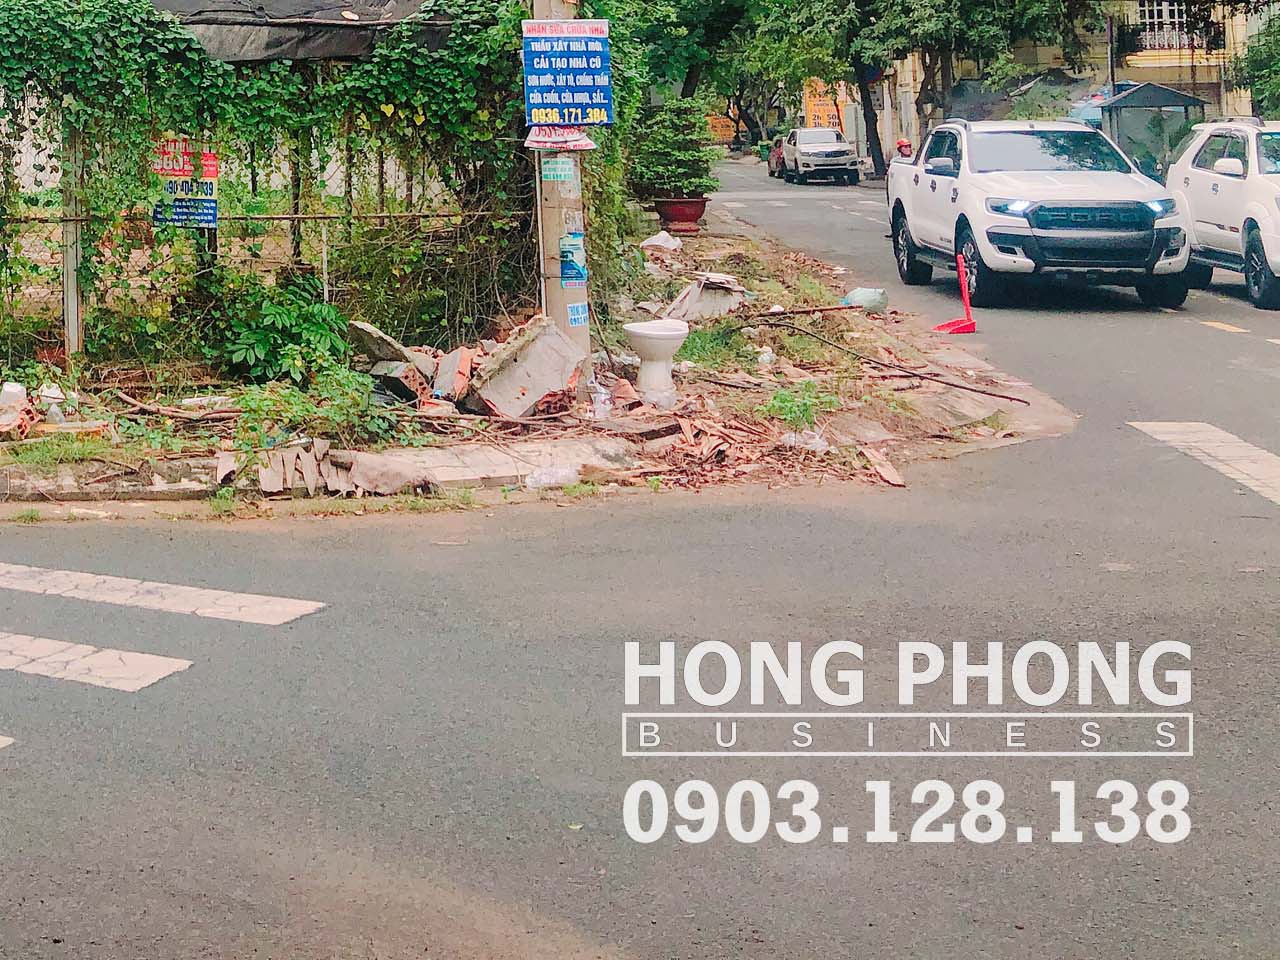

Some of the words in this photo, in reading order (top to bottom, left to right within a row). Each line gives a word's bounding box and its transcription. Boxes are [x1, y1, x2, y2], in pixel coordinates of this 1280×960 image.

[552, 40, 568, 52] XÂY
[569, 40, 587, 52] NHÀ
[533, 54, 549, 69] CẢI
[551, 57, 567, 71] TẠO
[569, 54, 588, 69] NHÀ
[589, 55, 601, 69] CŨ
